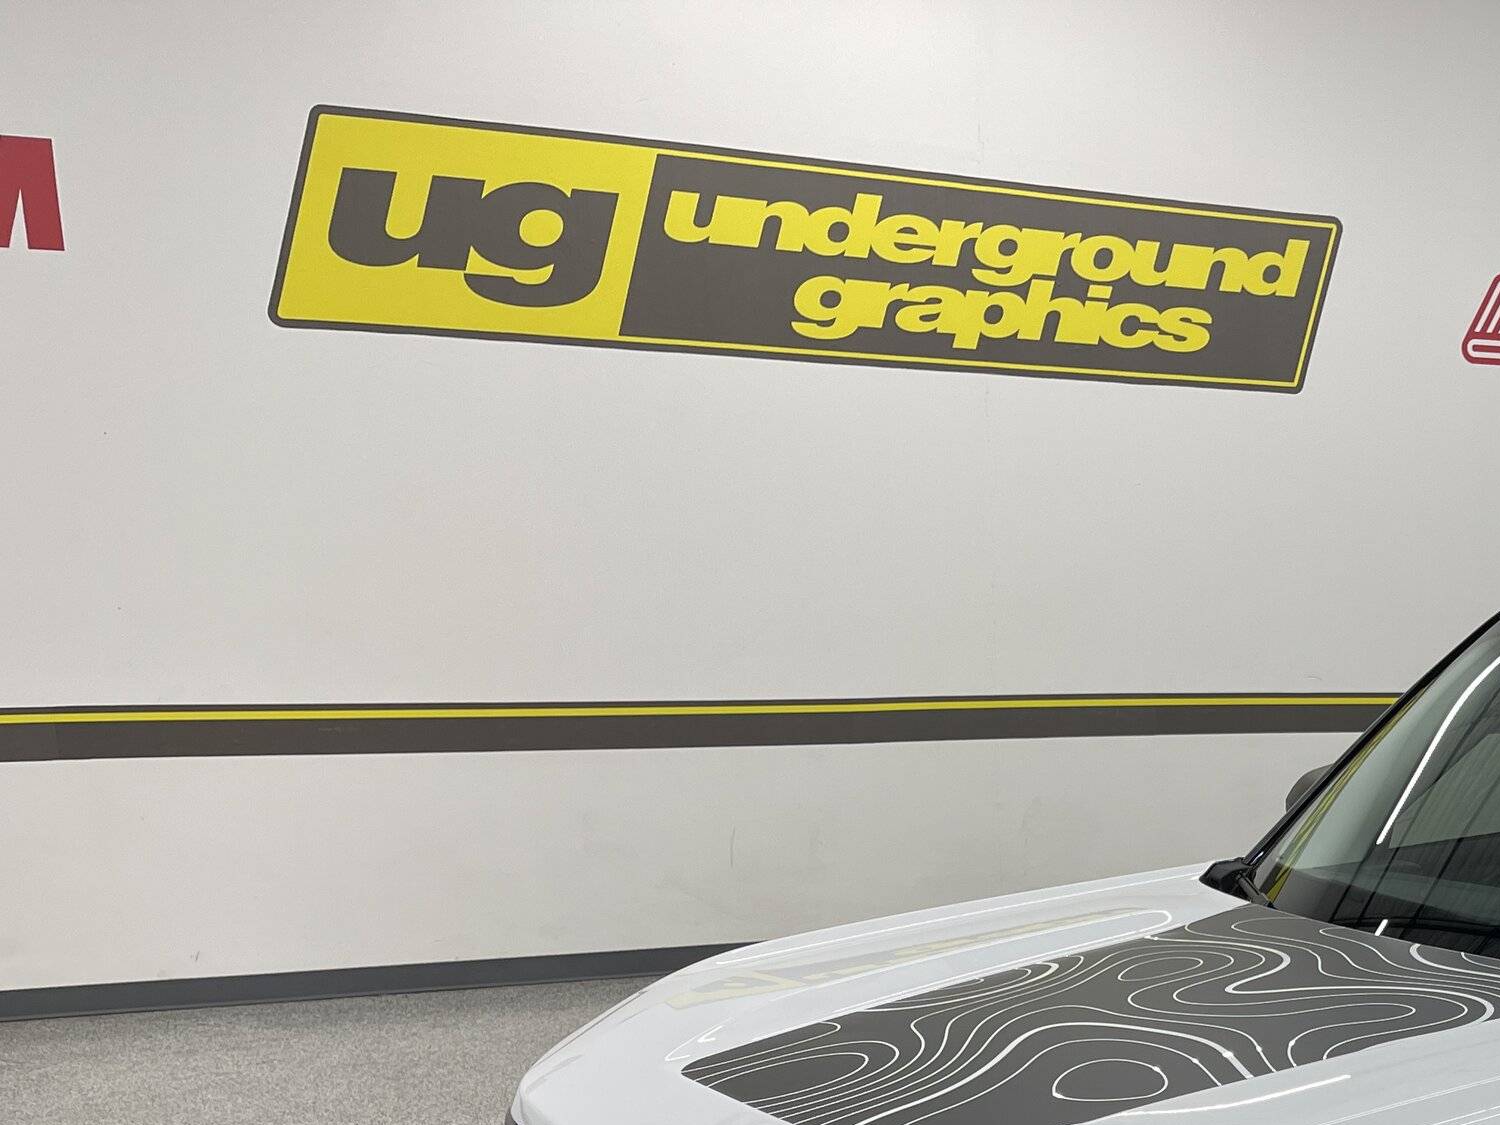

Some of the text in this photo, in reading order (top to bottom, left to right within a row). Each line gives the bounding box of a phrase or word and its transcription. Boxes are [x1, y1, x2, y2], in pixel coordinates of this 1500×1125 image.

[327, 166, 619, 308] ug
[663, 190, 1310, 298] underground
[791, 275, 1213, 353] graphics
